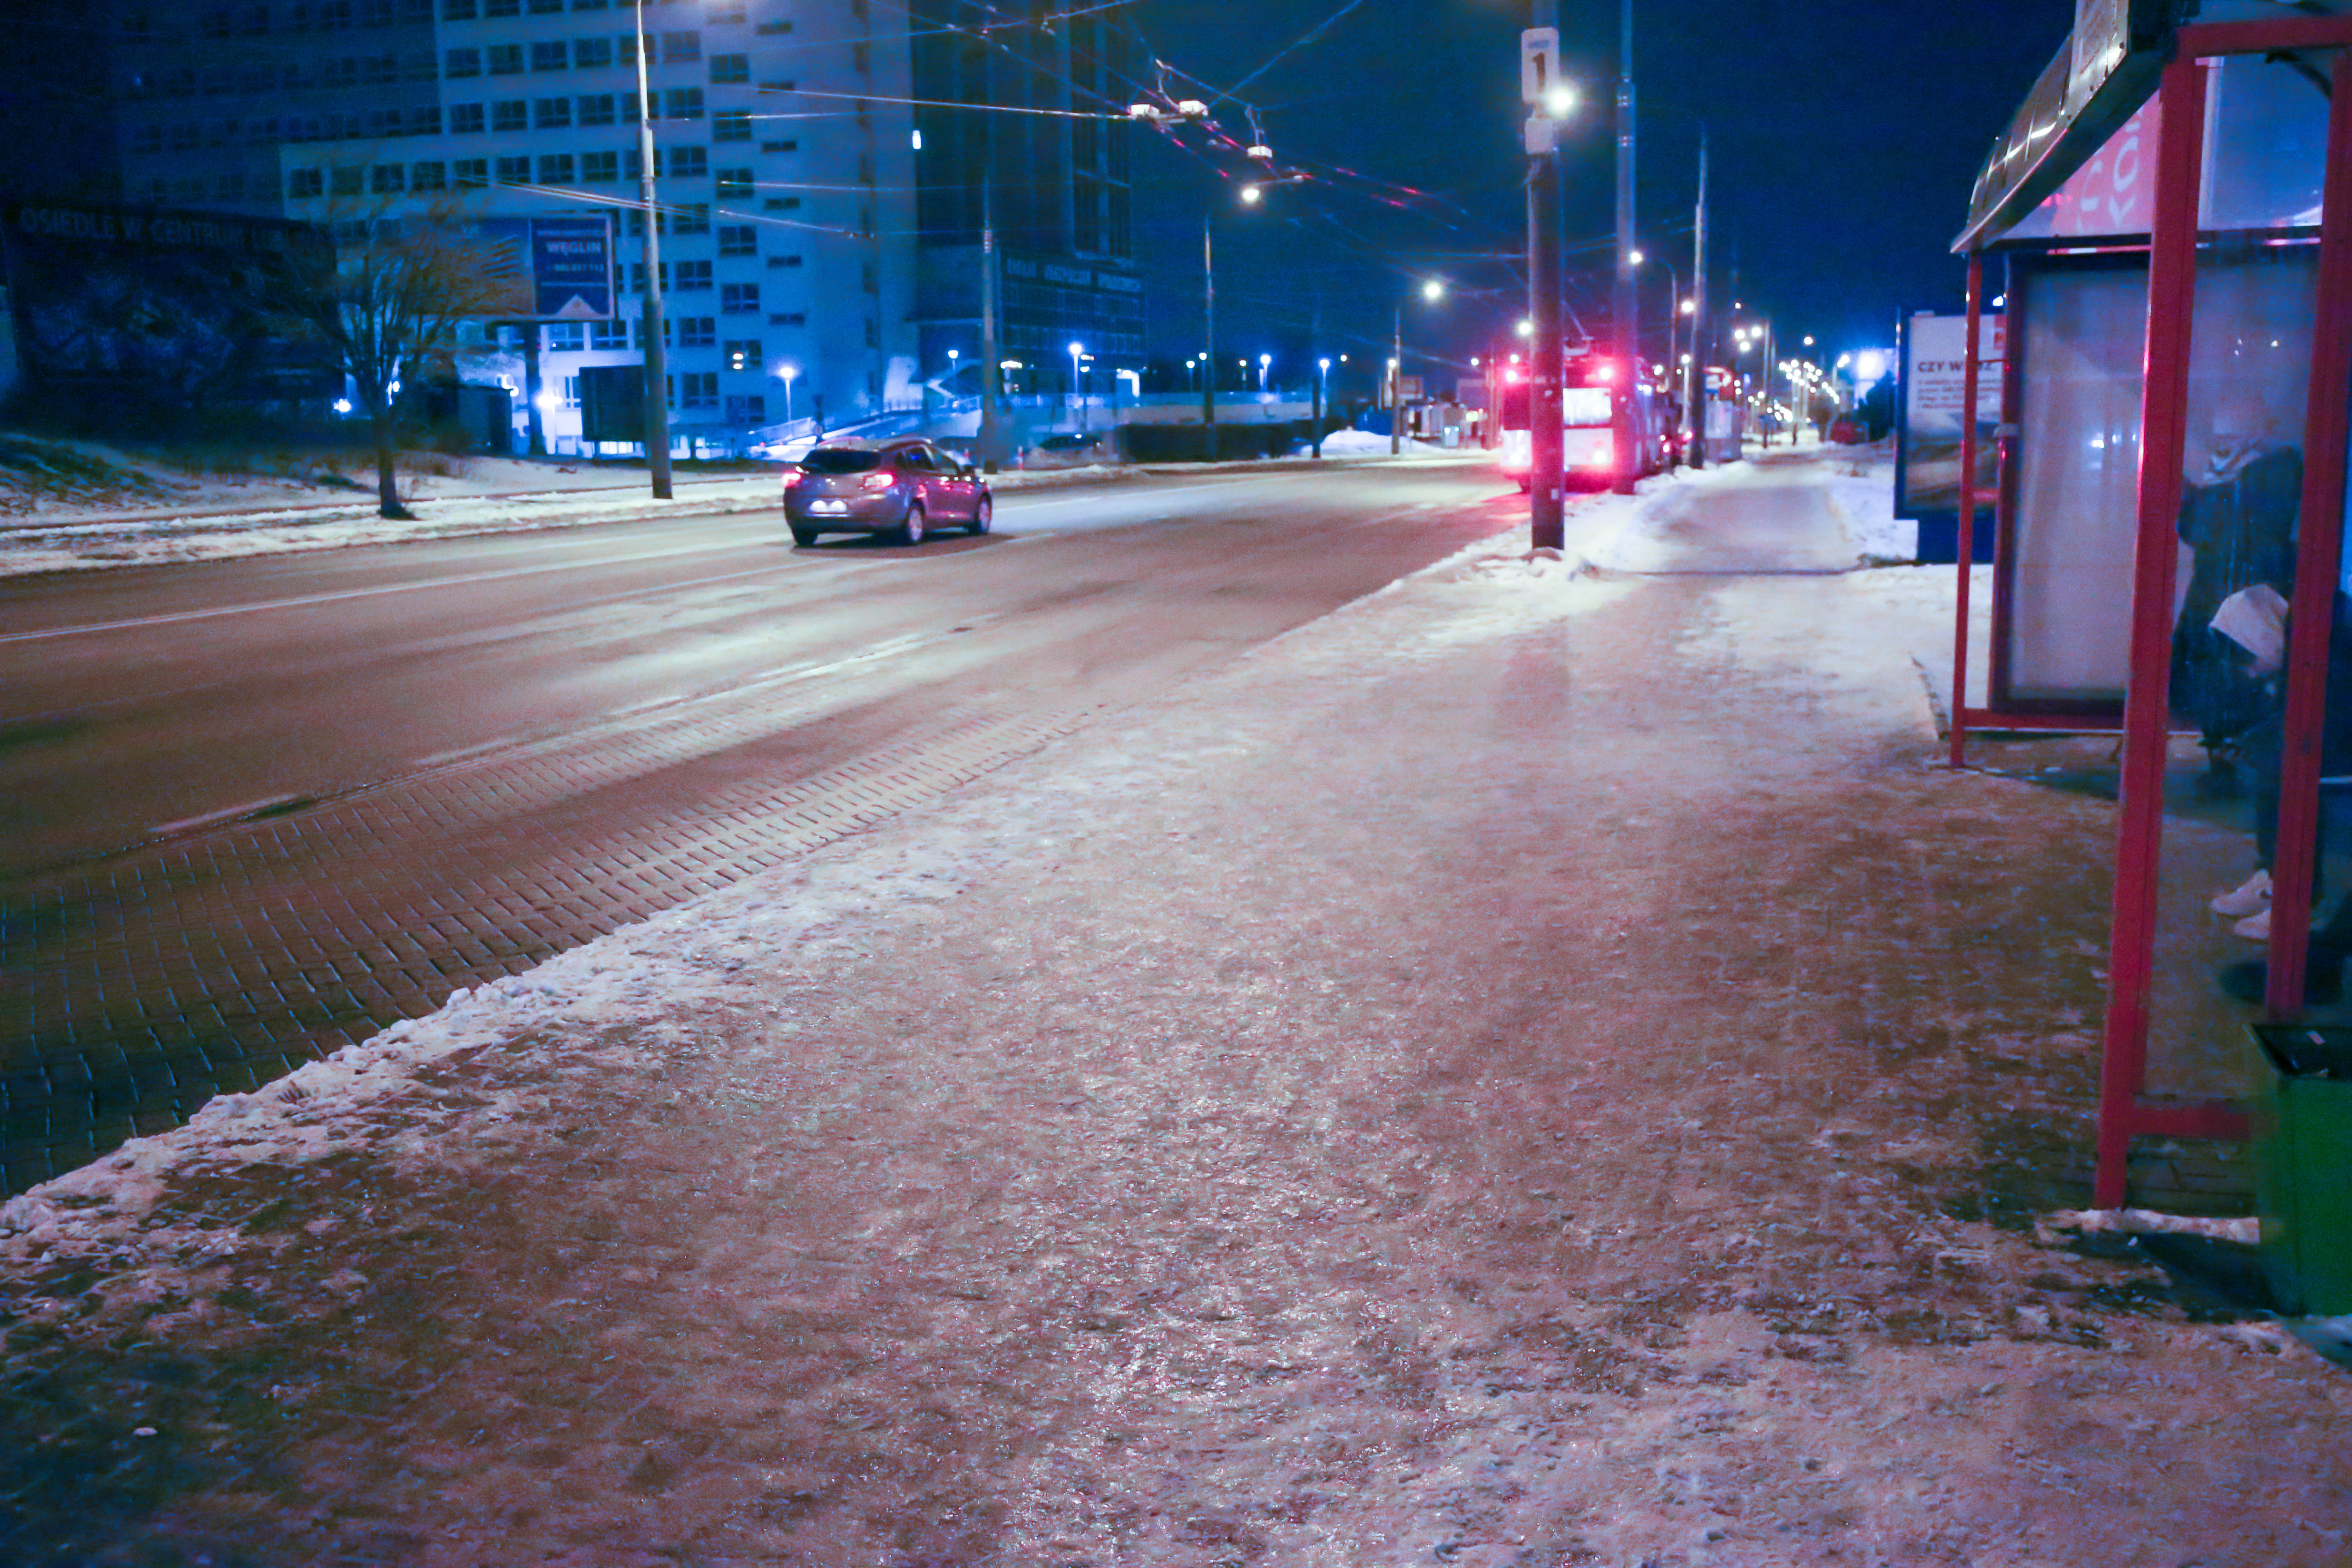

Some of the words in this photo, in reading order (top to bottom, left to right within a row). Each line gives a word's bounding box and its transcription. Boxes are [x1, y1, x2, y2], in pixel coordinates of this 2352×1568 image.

[20, 207, 115, 240] OSIEDLE
[121, 216, 142, 241] W
[149, 218, 244, 248] CENTRUM
[546, 240, 601, 256] WĘGLIN
[1917, 361, 1945, 372] CZY
